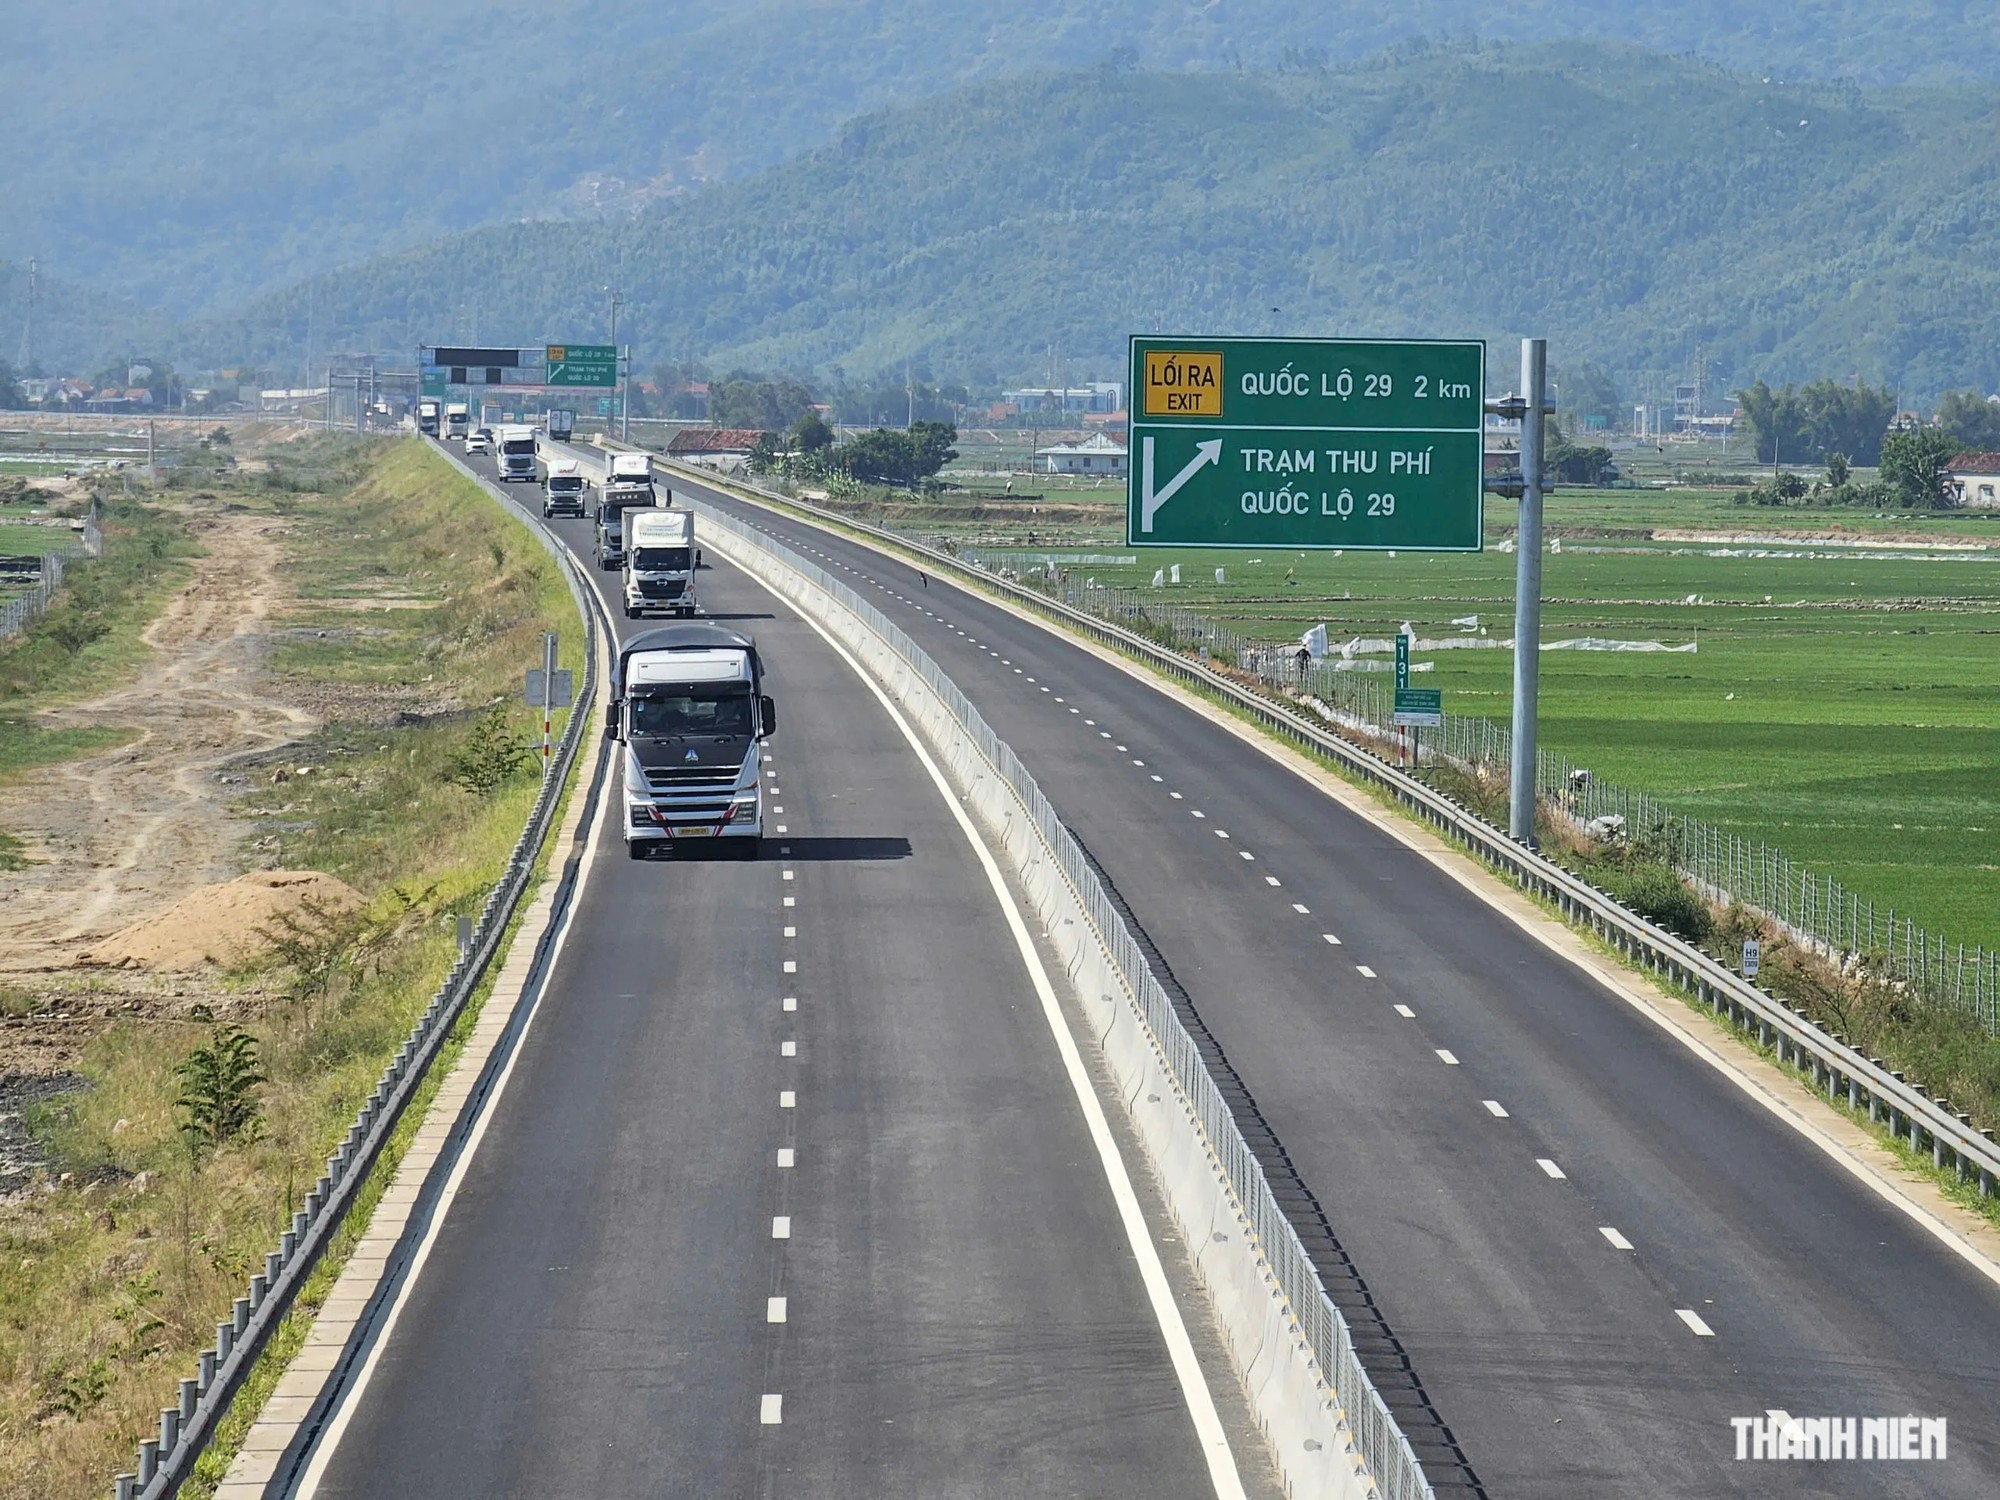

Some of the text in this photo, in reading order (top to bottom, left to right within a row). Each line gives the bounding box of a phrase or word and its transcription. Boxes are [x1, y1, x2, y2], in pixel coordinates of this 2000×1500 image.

[1151, 355, 1215, 387] LỐI RA
[1241, 361, 1471, 402] QUỐC LỘ 29 2 km
[1168, 393, 1202, 410] EXIT
[1240, 446, 1434, 477] TRẠM THU PHÍ
[1241, 481, 1395, 521] QUỐC LỘ 29
[1745, 948, 1757, 957] H9
